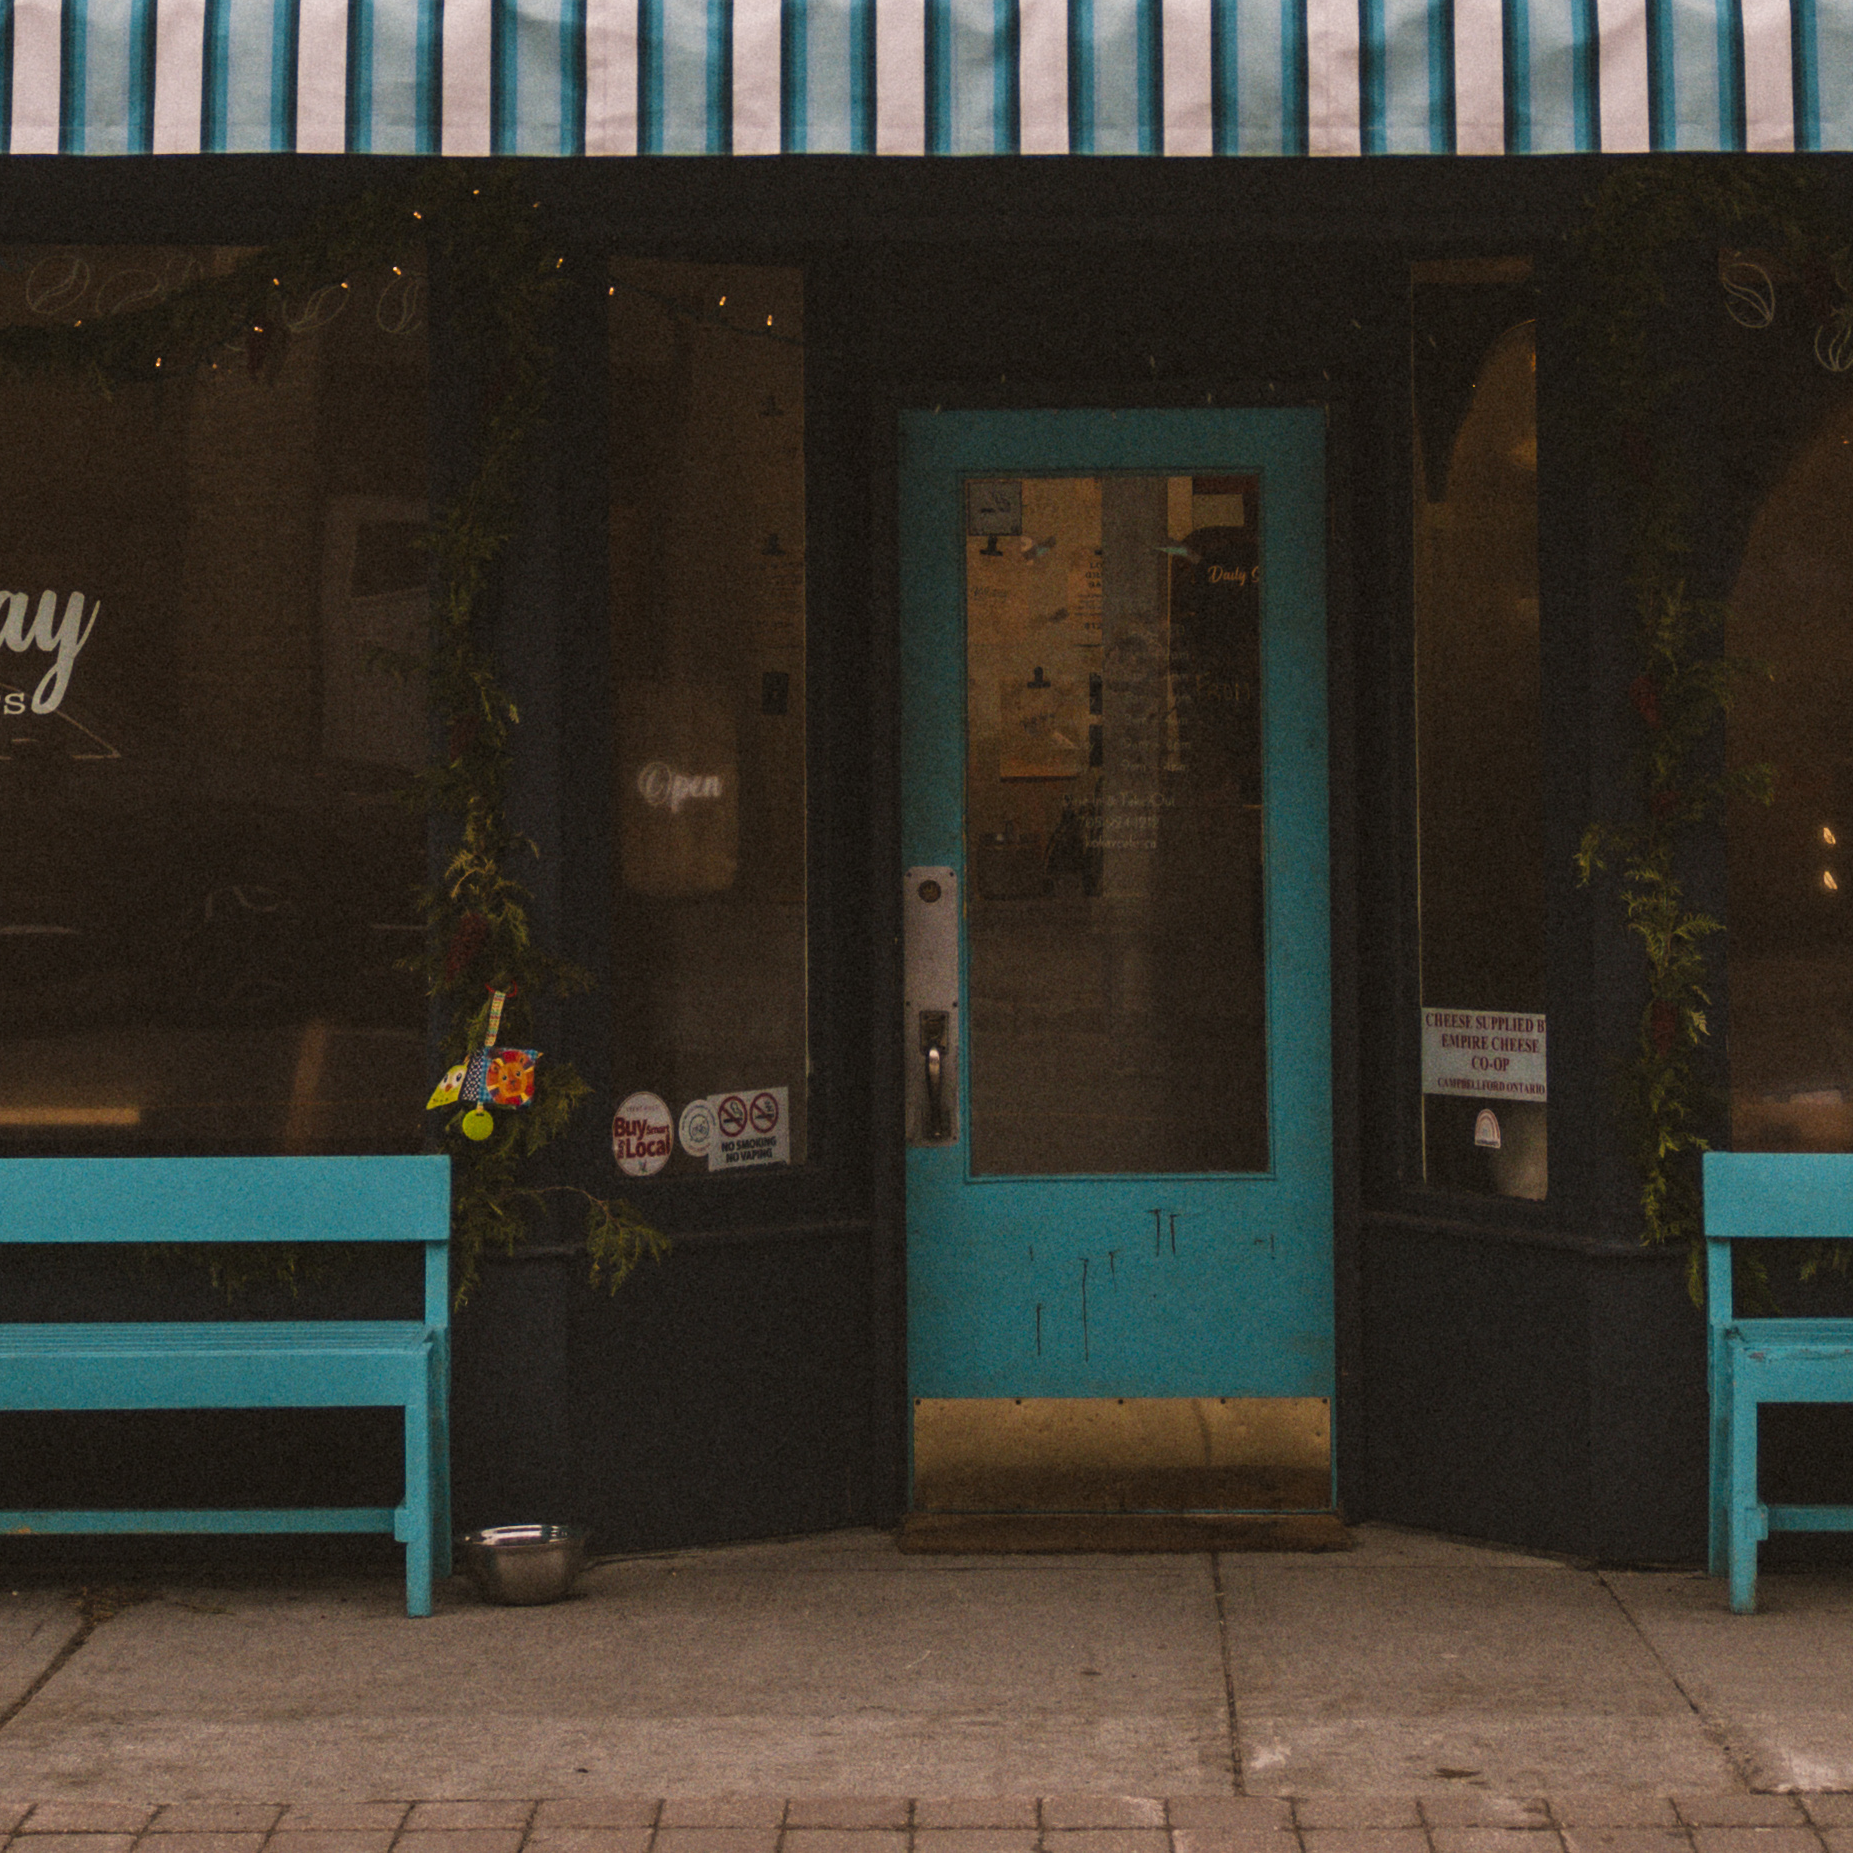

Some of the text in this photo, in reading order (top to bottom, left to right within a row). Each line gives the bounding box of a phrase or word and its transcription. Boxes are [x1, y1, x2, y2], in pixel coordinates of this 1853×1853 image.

[1207, 565, 1247, 587] Daily
[637, 761, 722, 814] Open
[1425, 1012, 1472, 1029] CHEESE
[1475, 1015, 1534, 1033] SUPPLIED
[1441, 1034, 1539, 1053] EMPIRE CHEESE
[1471, 1055, 1510, 1072] CO-OP
[1437, 1077, 1546, 1095] CAMPBELLFORD ONTARIO
[614, 1117, 647, 1141] Buy
[626, 1133, 671, 1159] Local
[721, 1136, 777, 1153] NO SMOKING
[726, 1148, 773, 1163] NO VAPING
